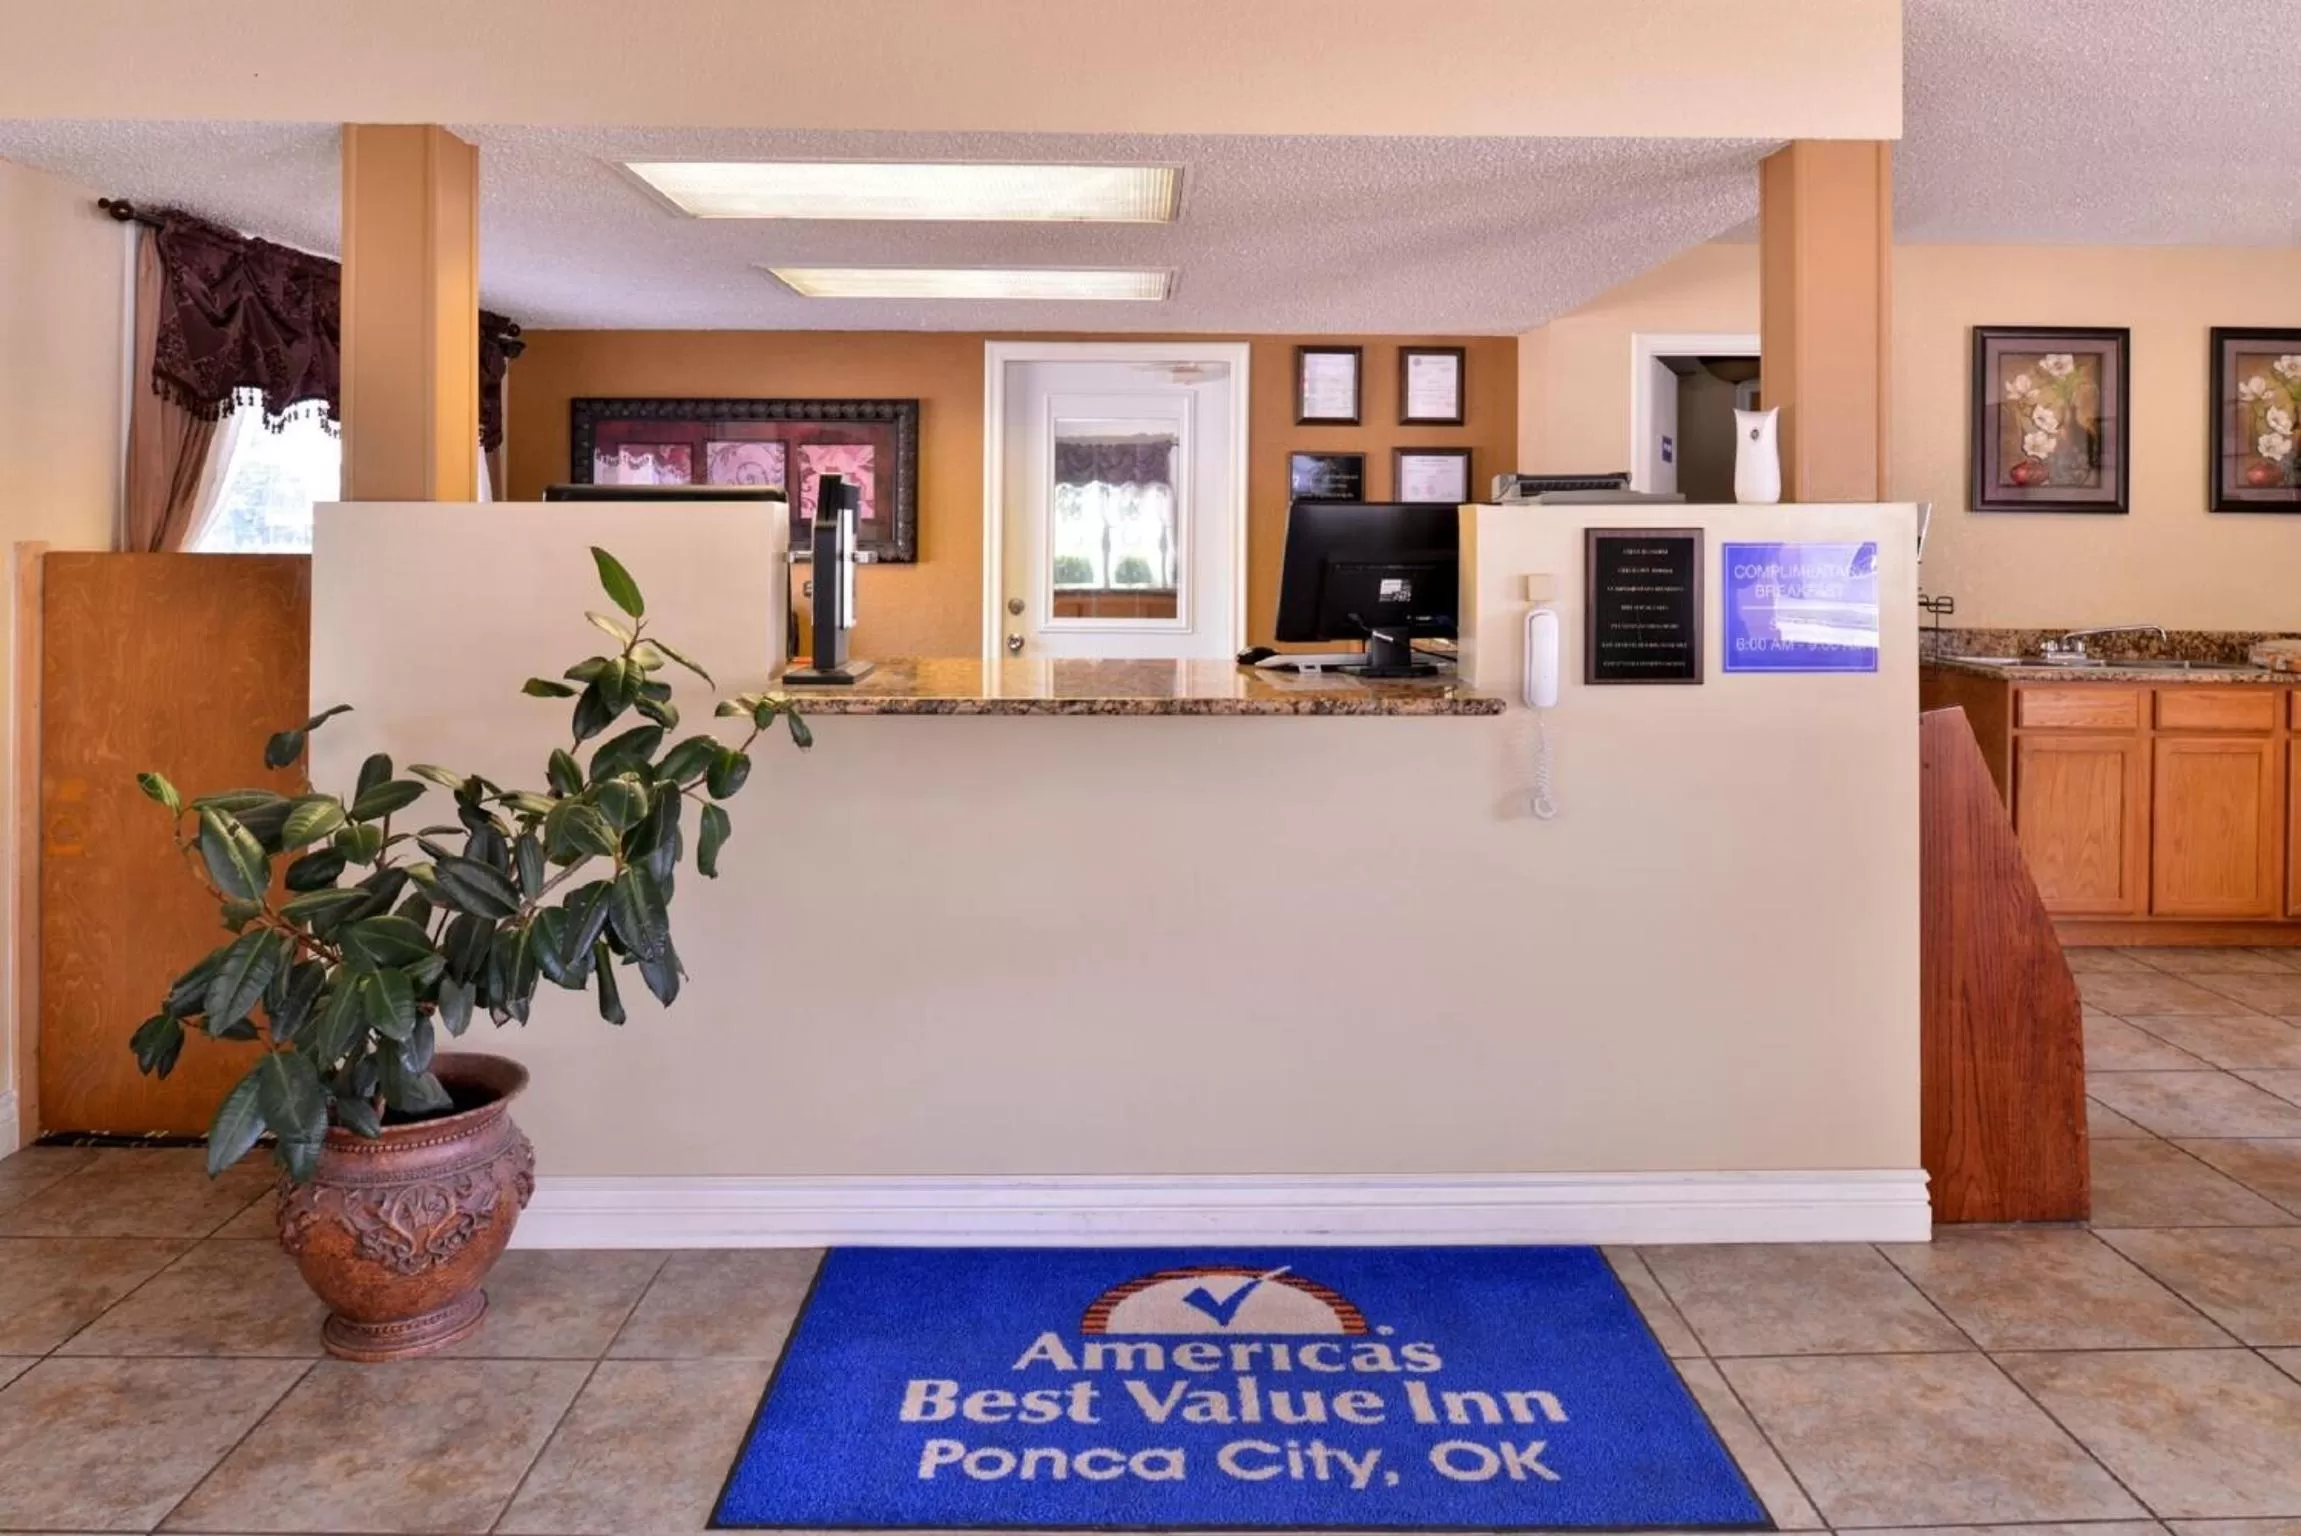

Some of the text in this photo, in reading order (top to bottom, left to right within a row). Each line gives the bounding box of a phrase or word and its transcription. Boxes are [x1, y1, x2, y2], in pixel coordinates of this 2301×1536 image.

[899, 1376, 1569, 1425] Best Value Inn
[918, 1439, 1560, 1489] Ponca City, OK
